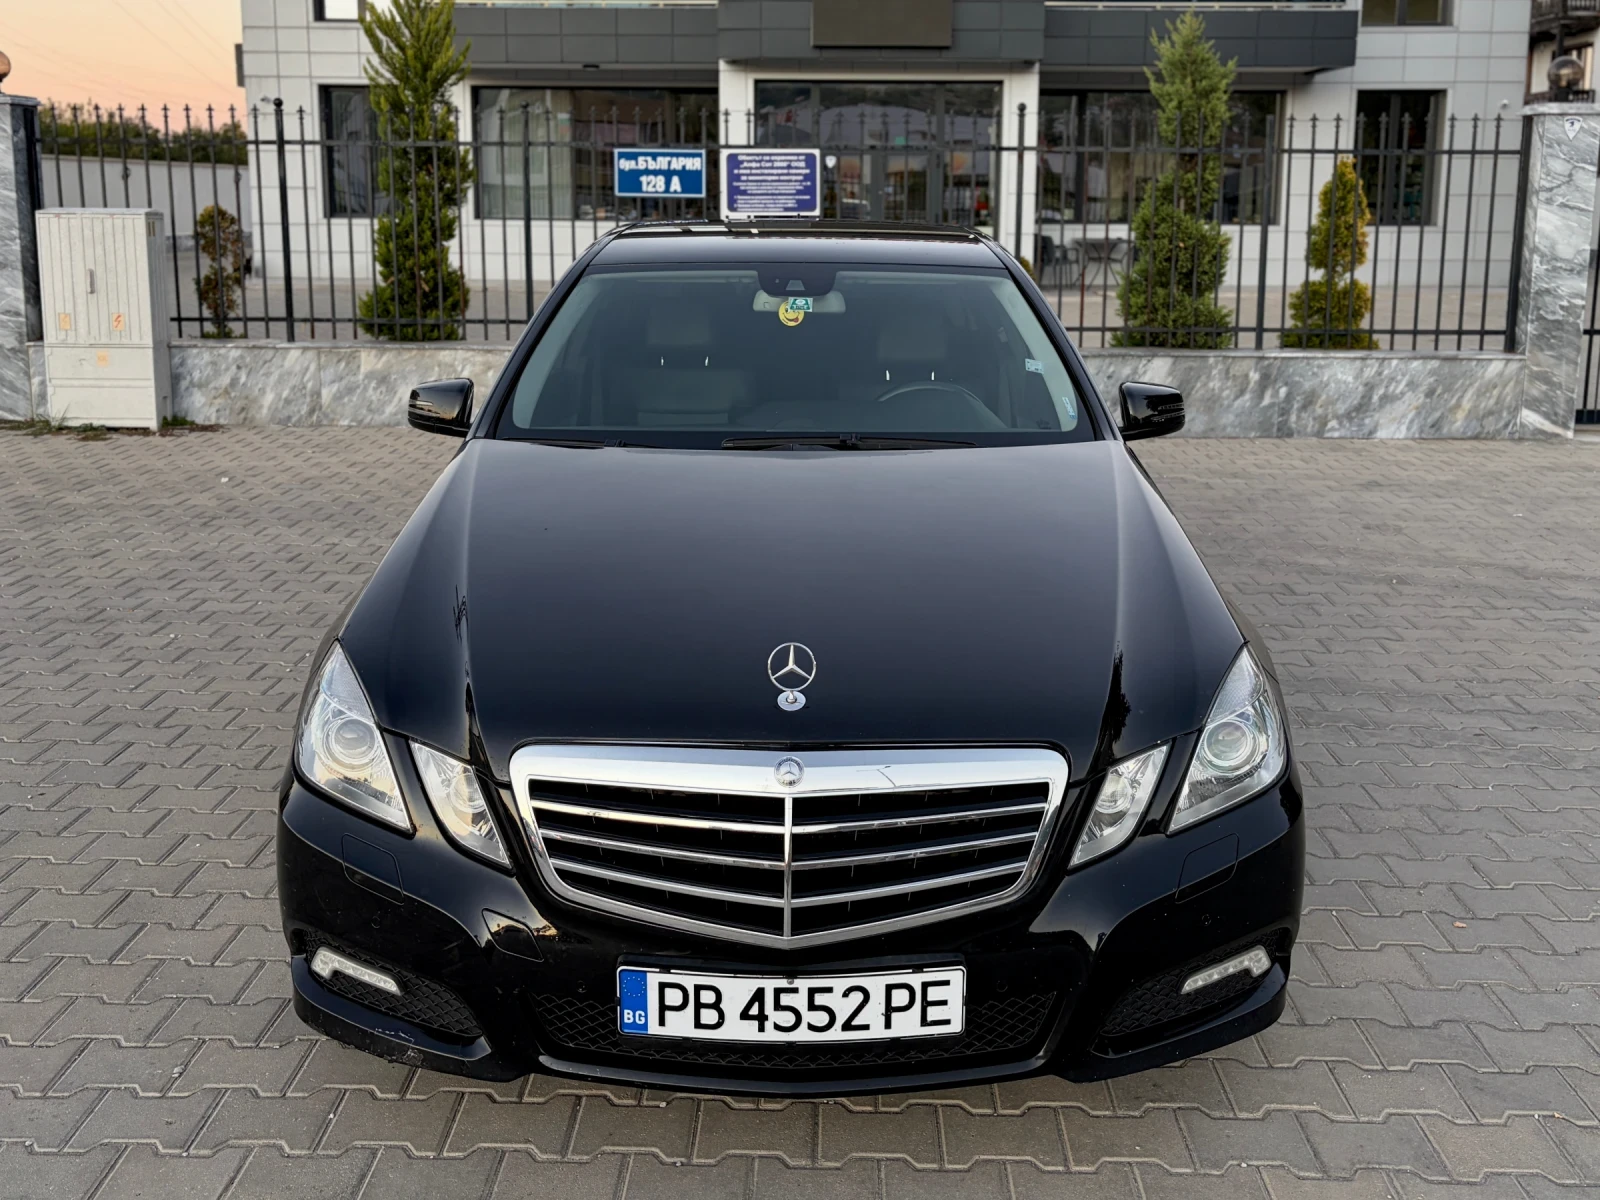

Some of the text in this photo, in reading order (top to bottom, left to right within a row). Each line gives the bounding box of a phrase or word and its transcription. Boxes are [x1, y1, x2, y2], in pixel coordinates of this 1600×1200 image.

[639, 175, 665, 192] 128
[657, 980, 952, 1033] PB 4552 PE
[623, 1010, 646, 1025] BG
